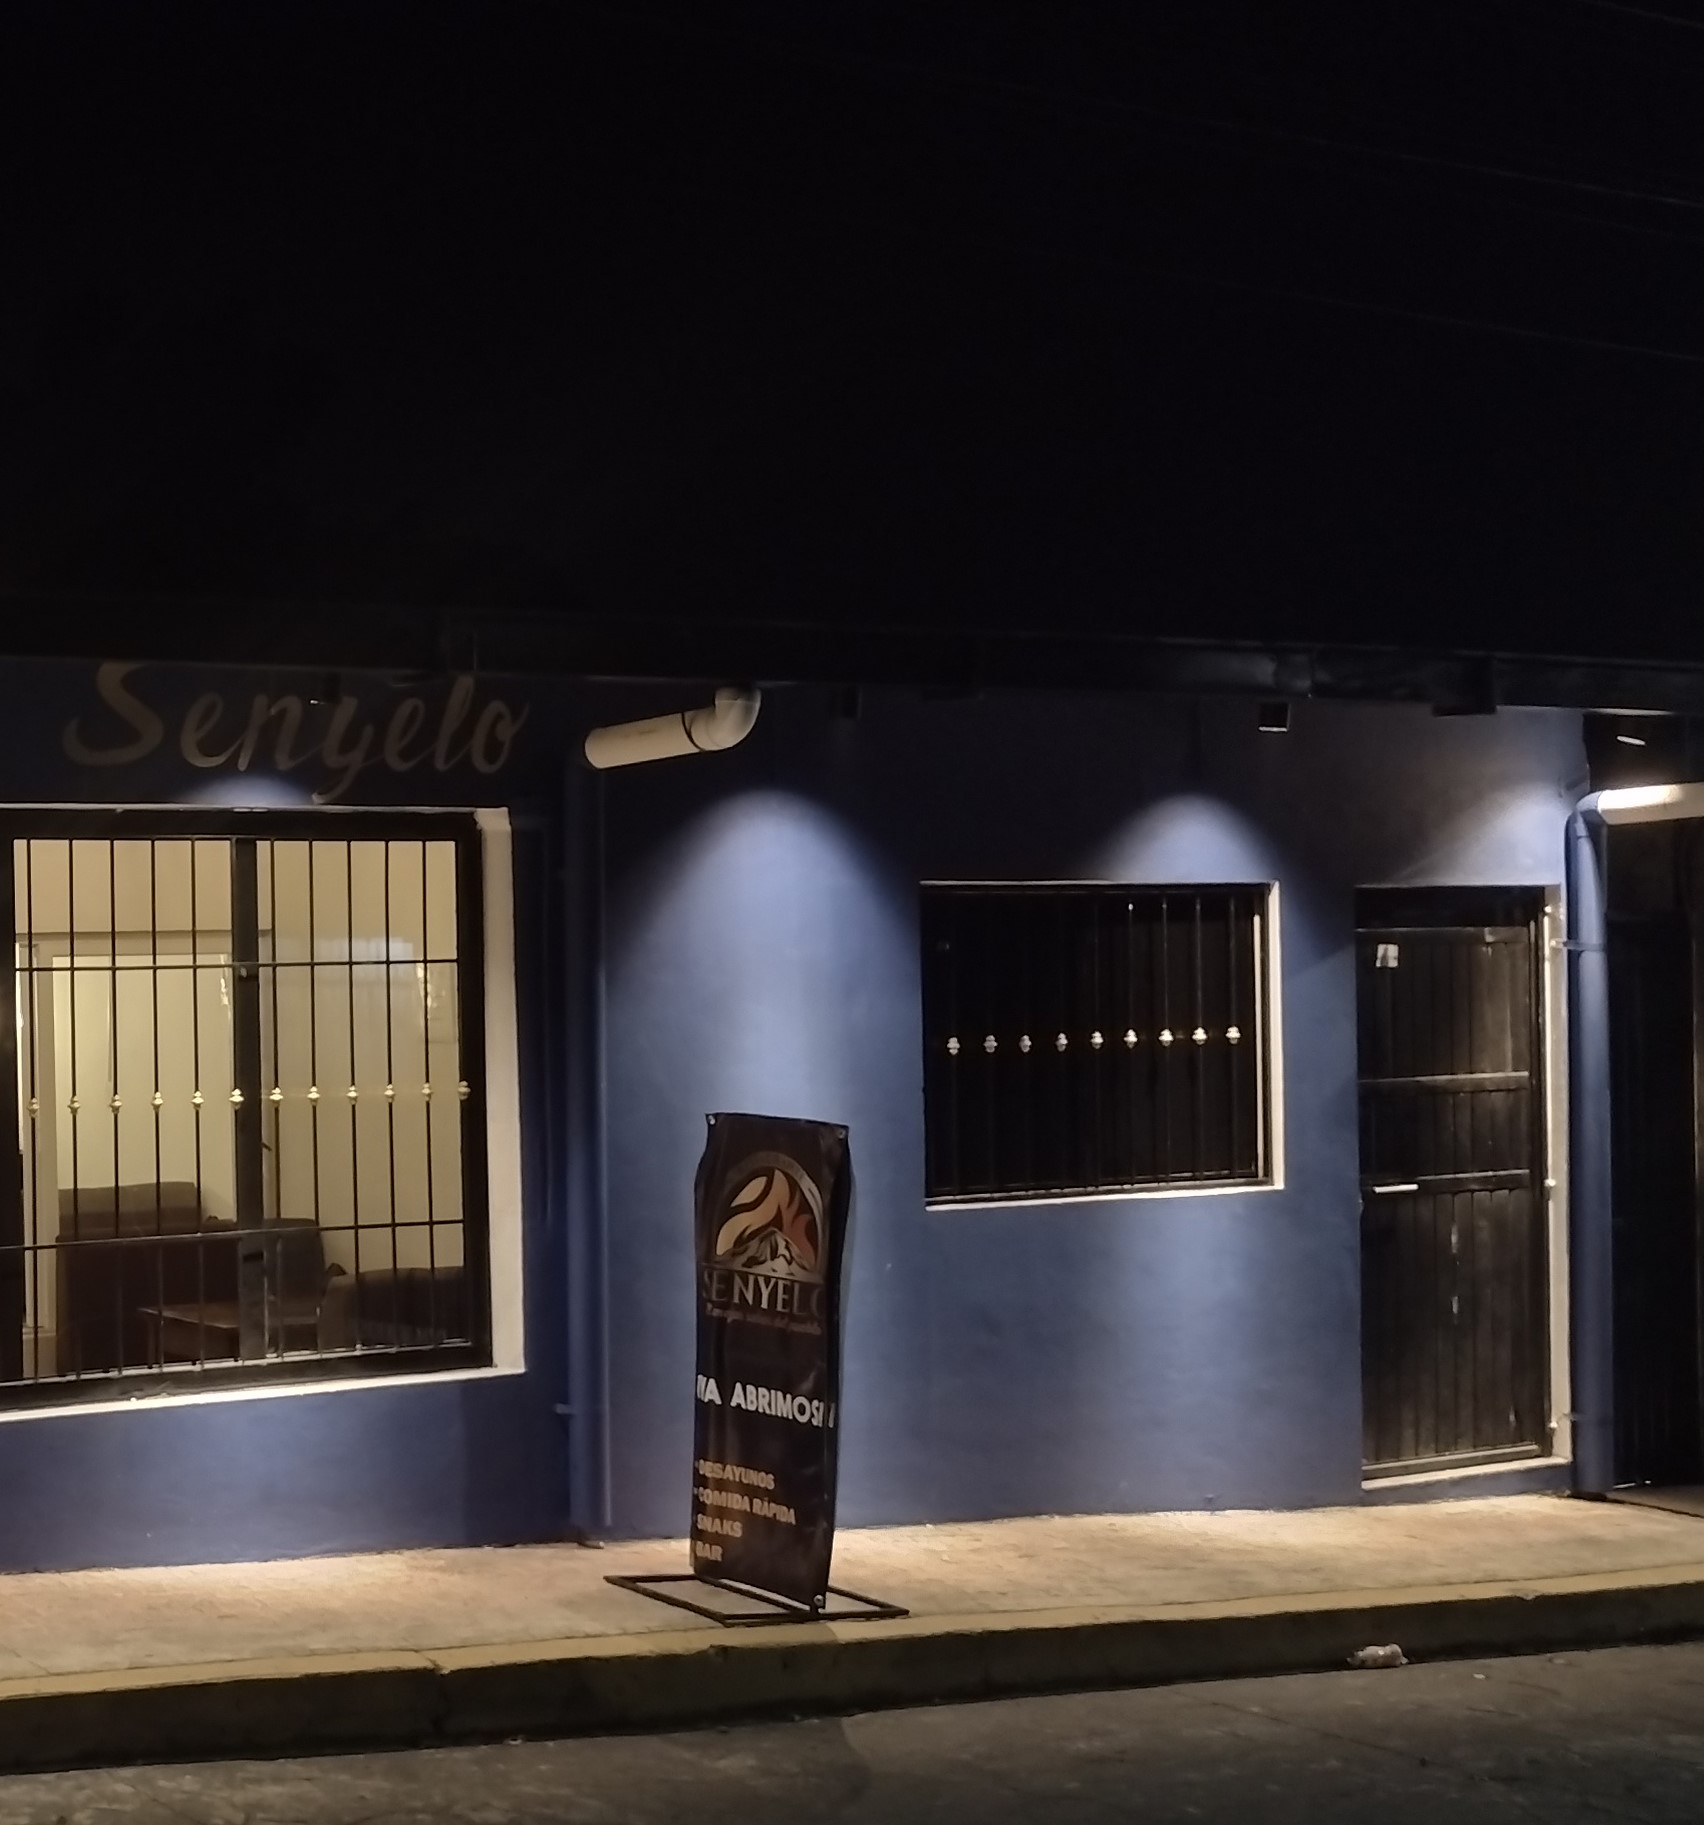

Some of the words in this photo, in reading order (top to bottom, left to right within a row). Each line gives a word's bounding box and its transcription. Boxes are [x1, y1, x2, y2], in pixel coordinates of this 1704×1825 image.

[61, 661, 531, 805] Senyelo
[698, 1486, 751, 1513] COMIDA
[696, 1513, 743, 1538] SNAKS
